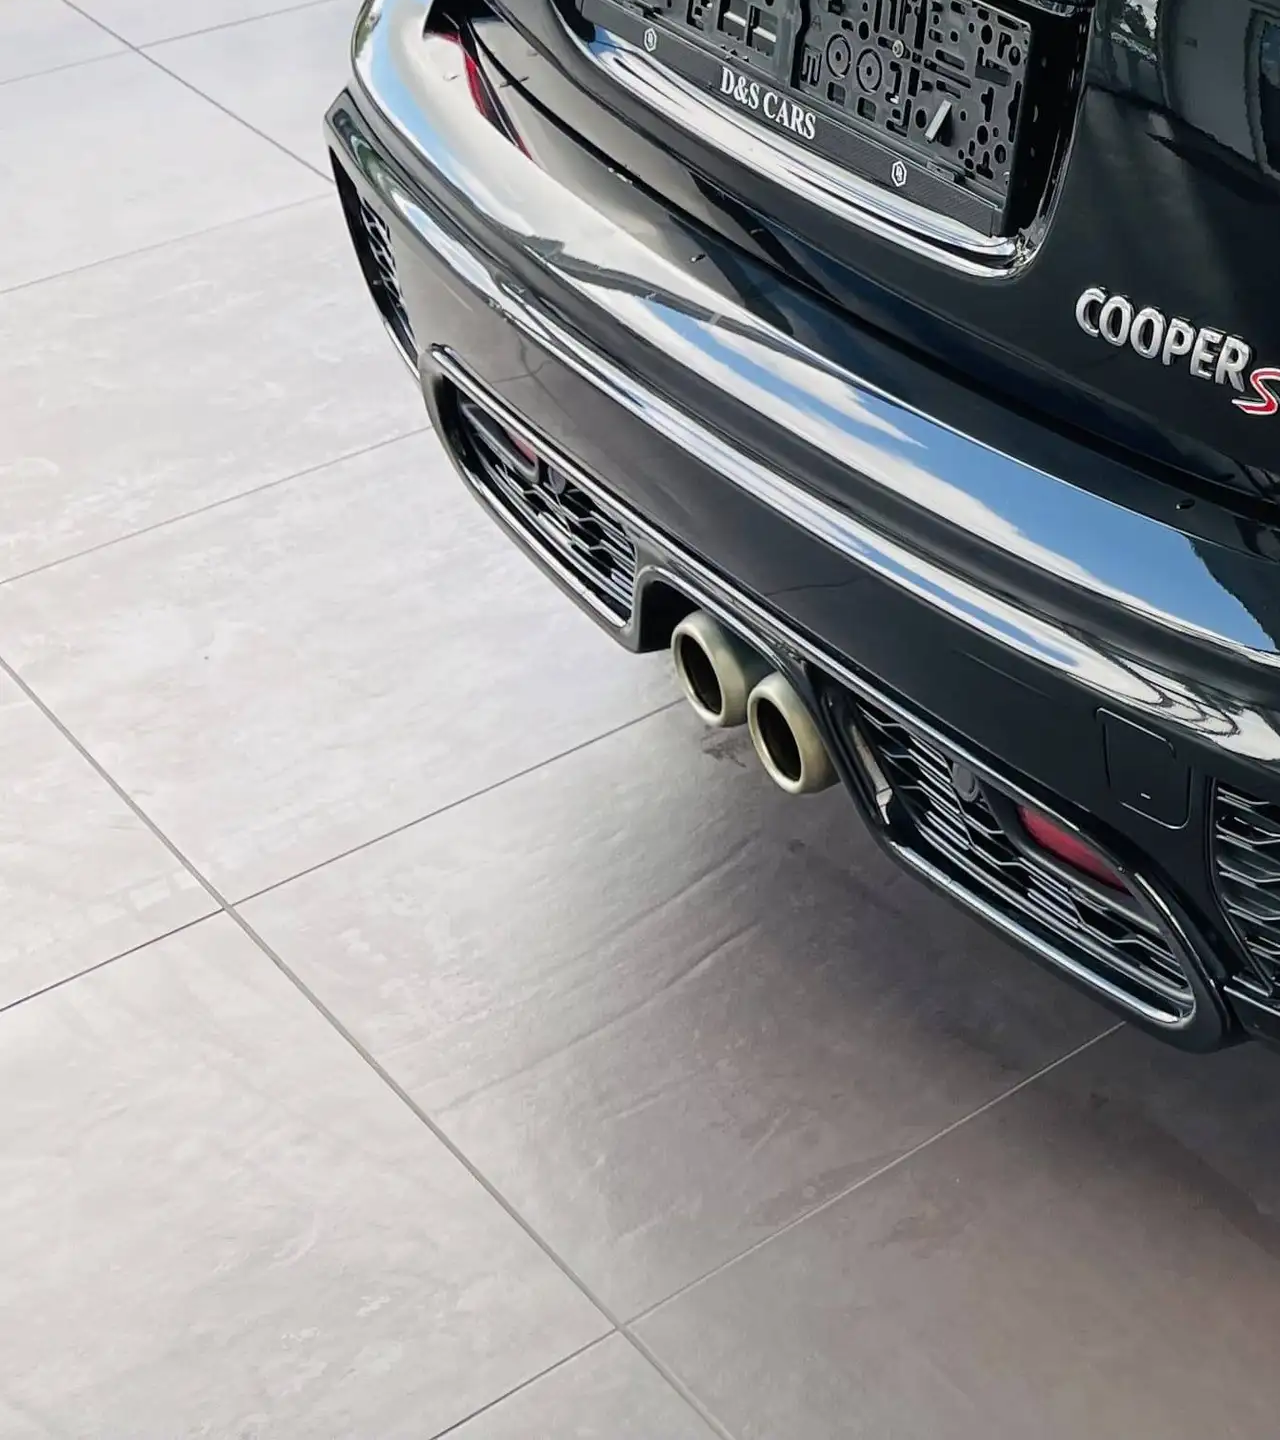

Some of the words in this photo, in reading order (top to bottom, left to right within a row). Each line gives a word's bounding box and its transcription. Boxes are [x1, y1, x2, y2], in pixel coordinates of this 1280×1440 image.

[719, 66, 760, 110] D&S
[763, 91, 816, 140] CARS
[1075, 287, 1253, 393] COOPER
